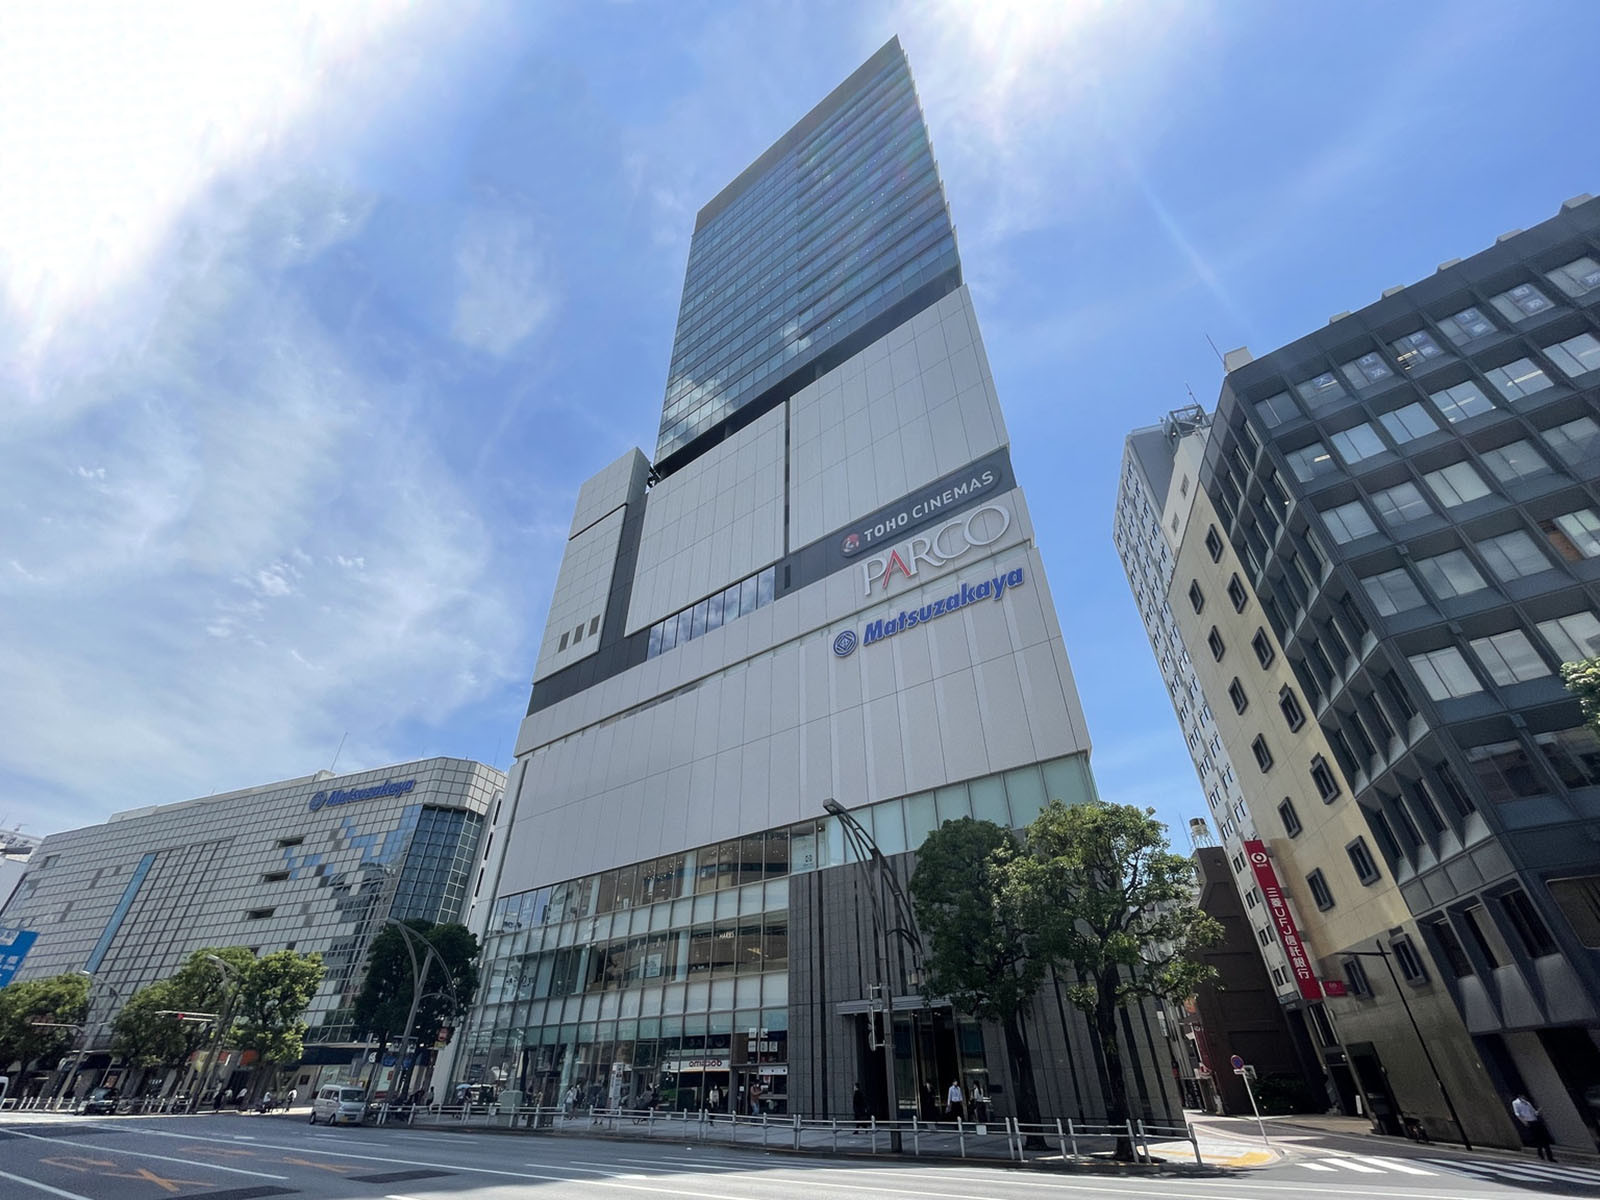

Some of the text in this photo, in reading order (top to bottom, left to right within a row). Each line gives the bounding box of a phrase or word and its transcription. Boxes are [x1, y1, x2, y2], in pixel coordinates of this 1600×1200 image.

[864, 470, 994, 542] TOHO CINEMAS
[860, 505, 1011, 597] PARCO
[863, 567, 1025, 646] Matsuzakaya
[326, 779, 416, 807] Matsuzakaya
